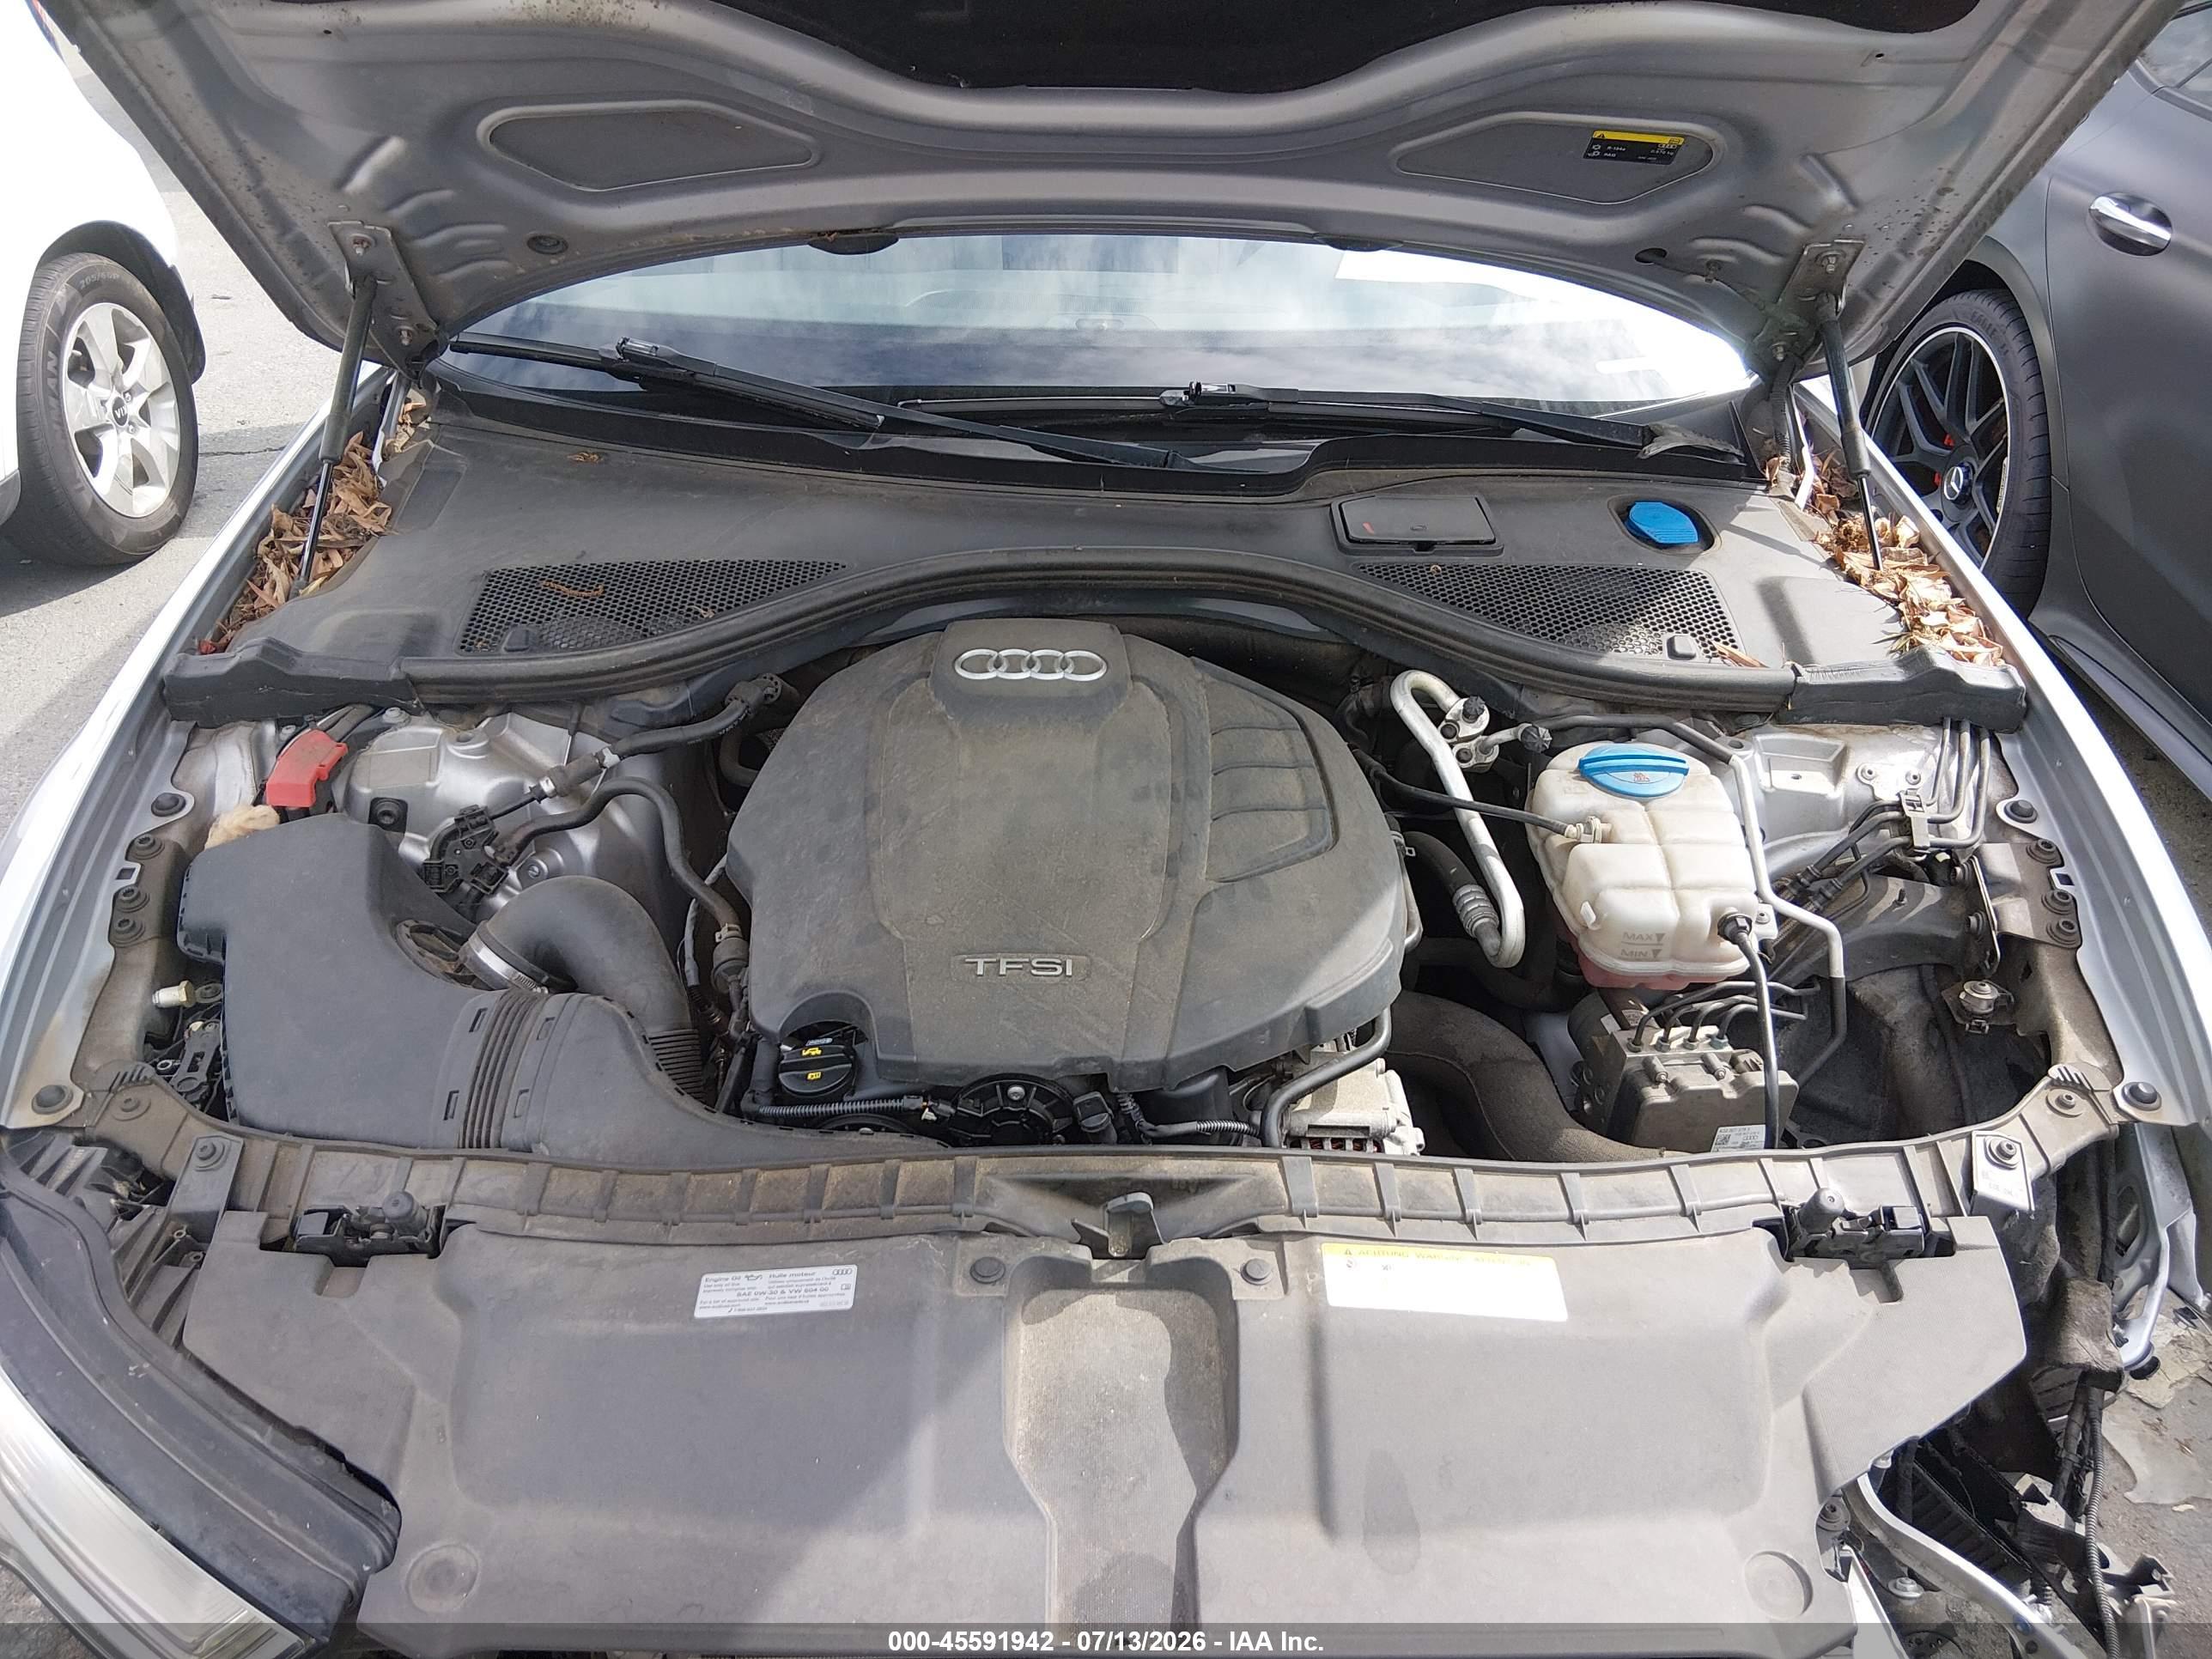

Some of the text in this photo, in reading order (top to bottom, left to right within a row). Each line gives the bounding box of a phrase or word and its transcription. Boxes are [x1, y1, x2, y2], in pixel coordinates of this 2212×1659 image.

[1623, 932, 1654, 941] MAX
[1620, 948, 1650, 957] MIN
[964, 957, 1073, 977] TFSI
